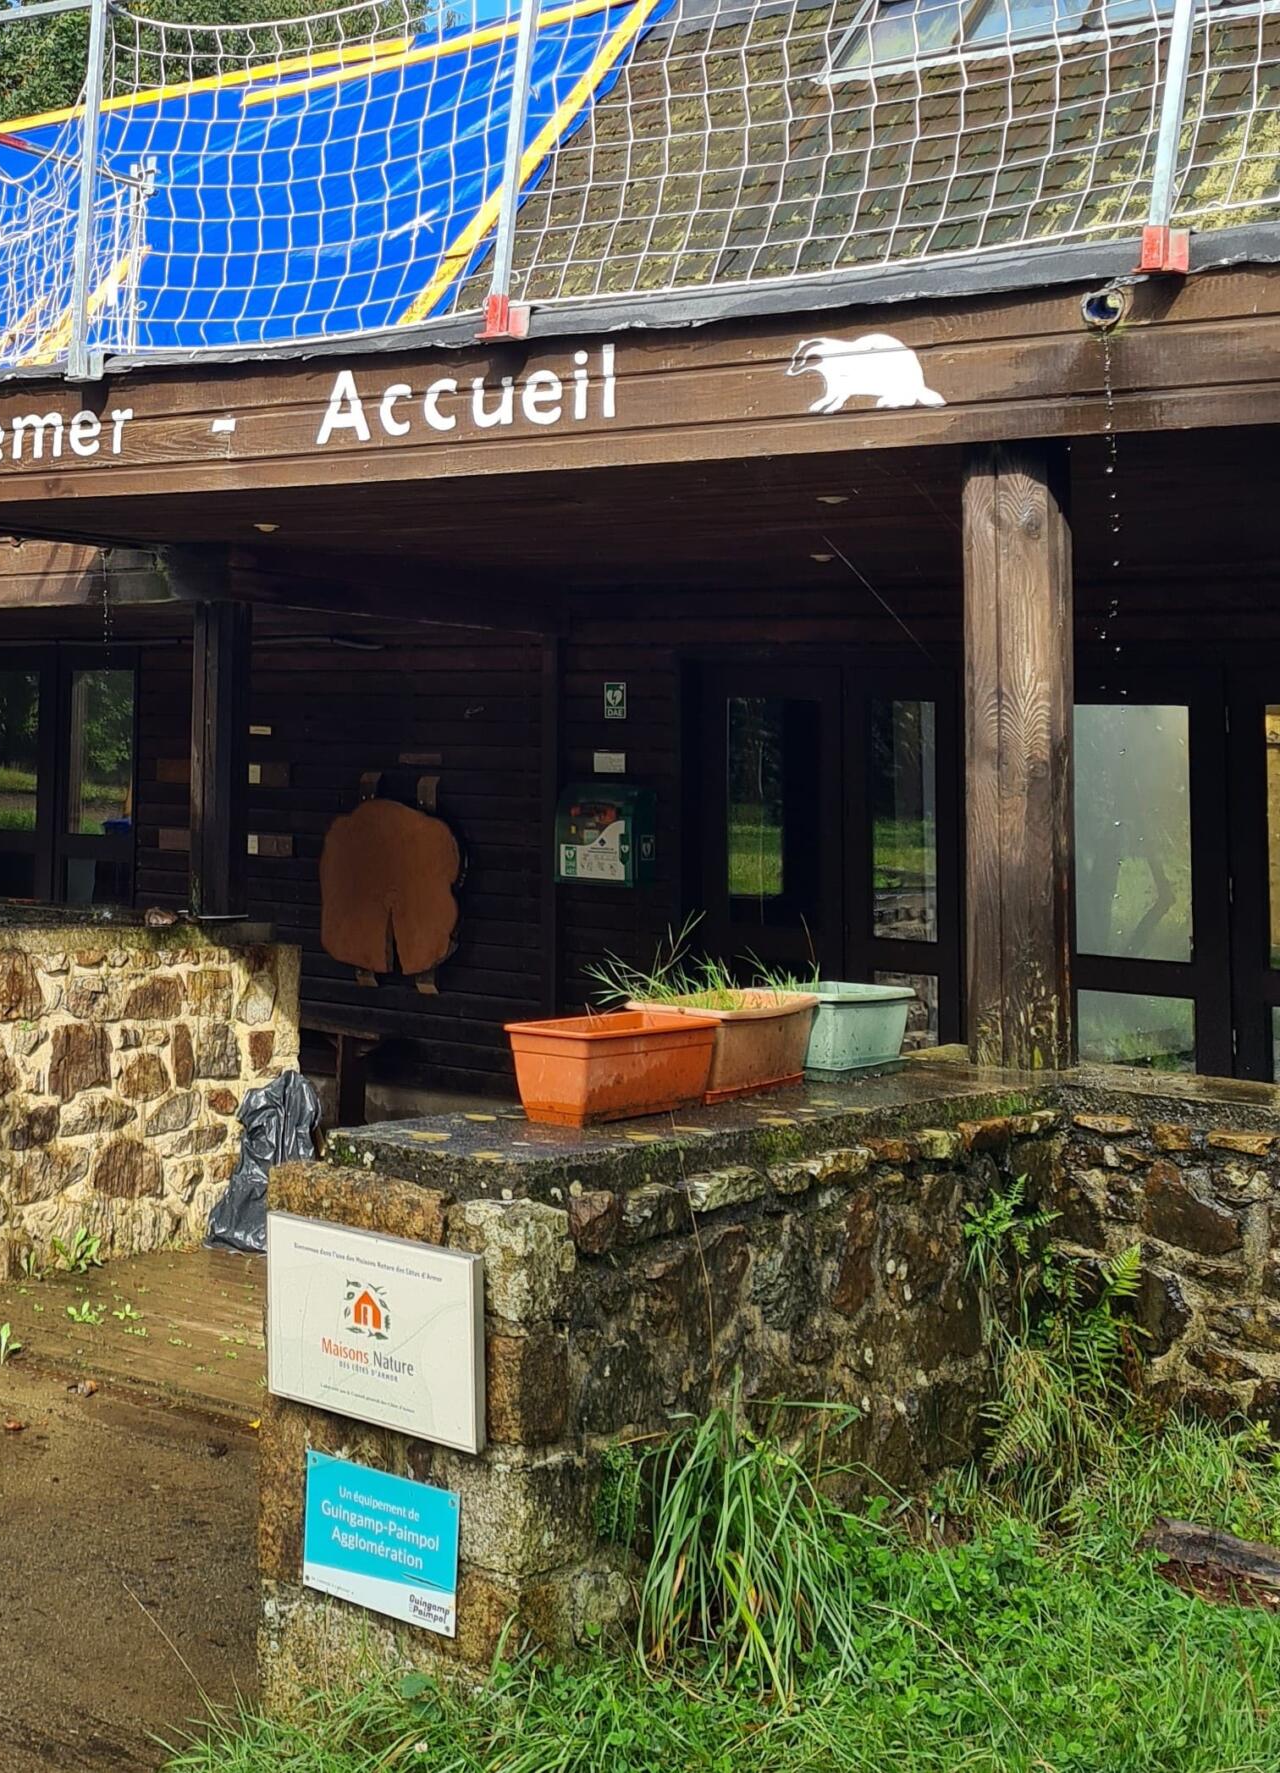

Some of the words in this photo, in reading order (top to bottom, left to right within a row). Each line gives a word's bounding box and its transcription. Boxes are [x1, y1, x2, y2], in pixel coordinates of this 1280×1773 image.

[316, 343, 616, 445] Accueil
[607, 708, 624, 717] DAE
[321, 1337, 369, 1365] Maisons
[373, 1350, 414, 1377] Nature
[339, 1485, 352, 1500] Un
[353, 1491, 406, 1518] équipement
[408, 1507, 420, 1522] de
[321, 1499, 440, 1552] Guingamp-Paimpol
[331, 1526, 423, 1570] Agglomération
